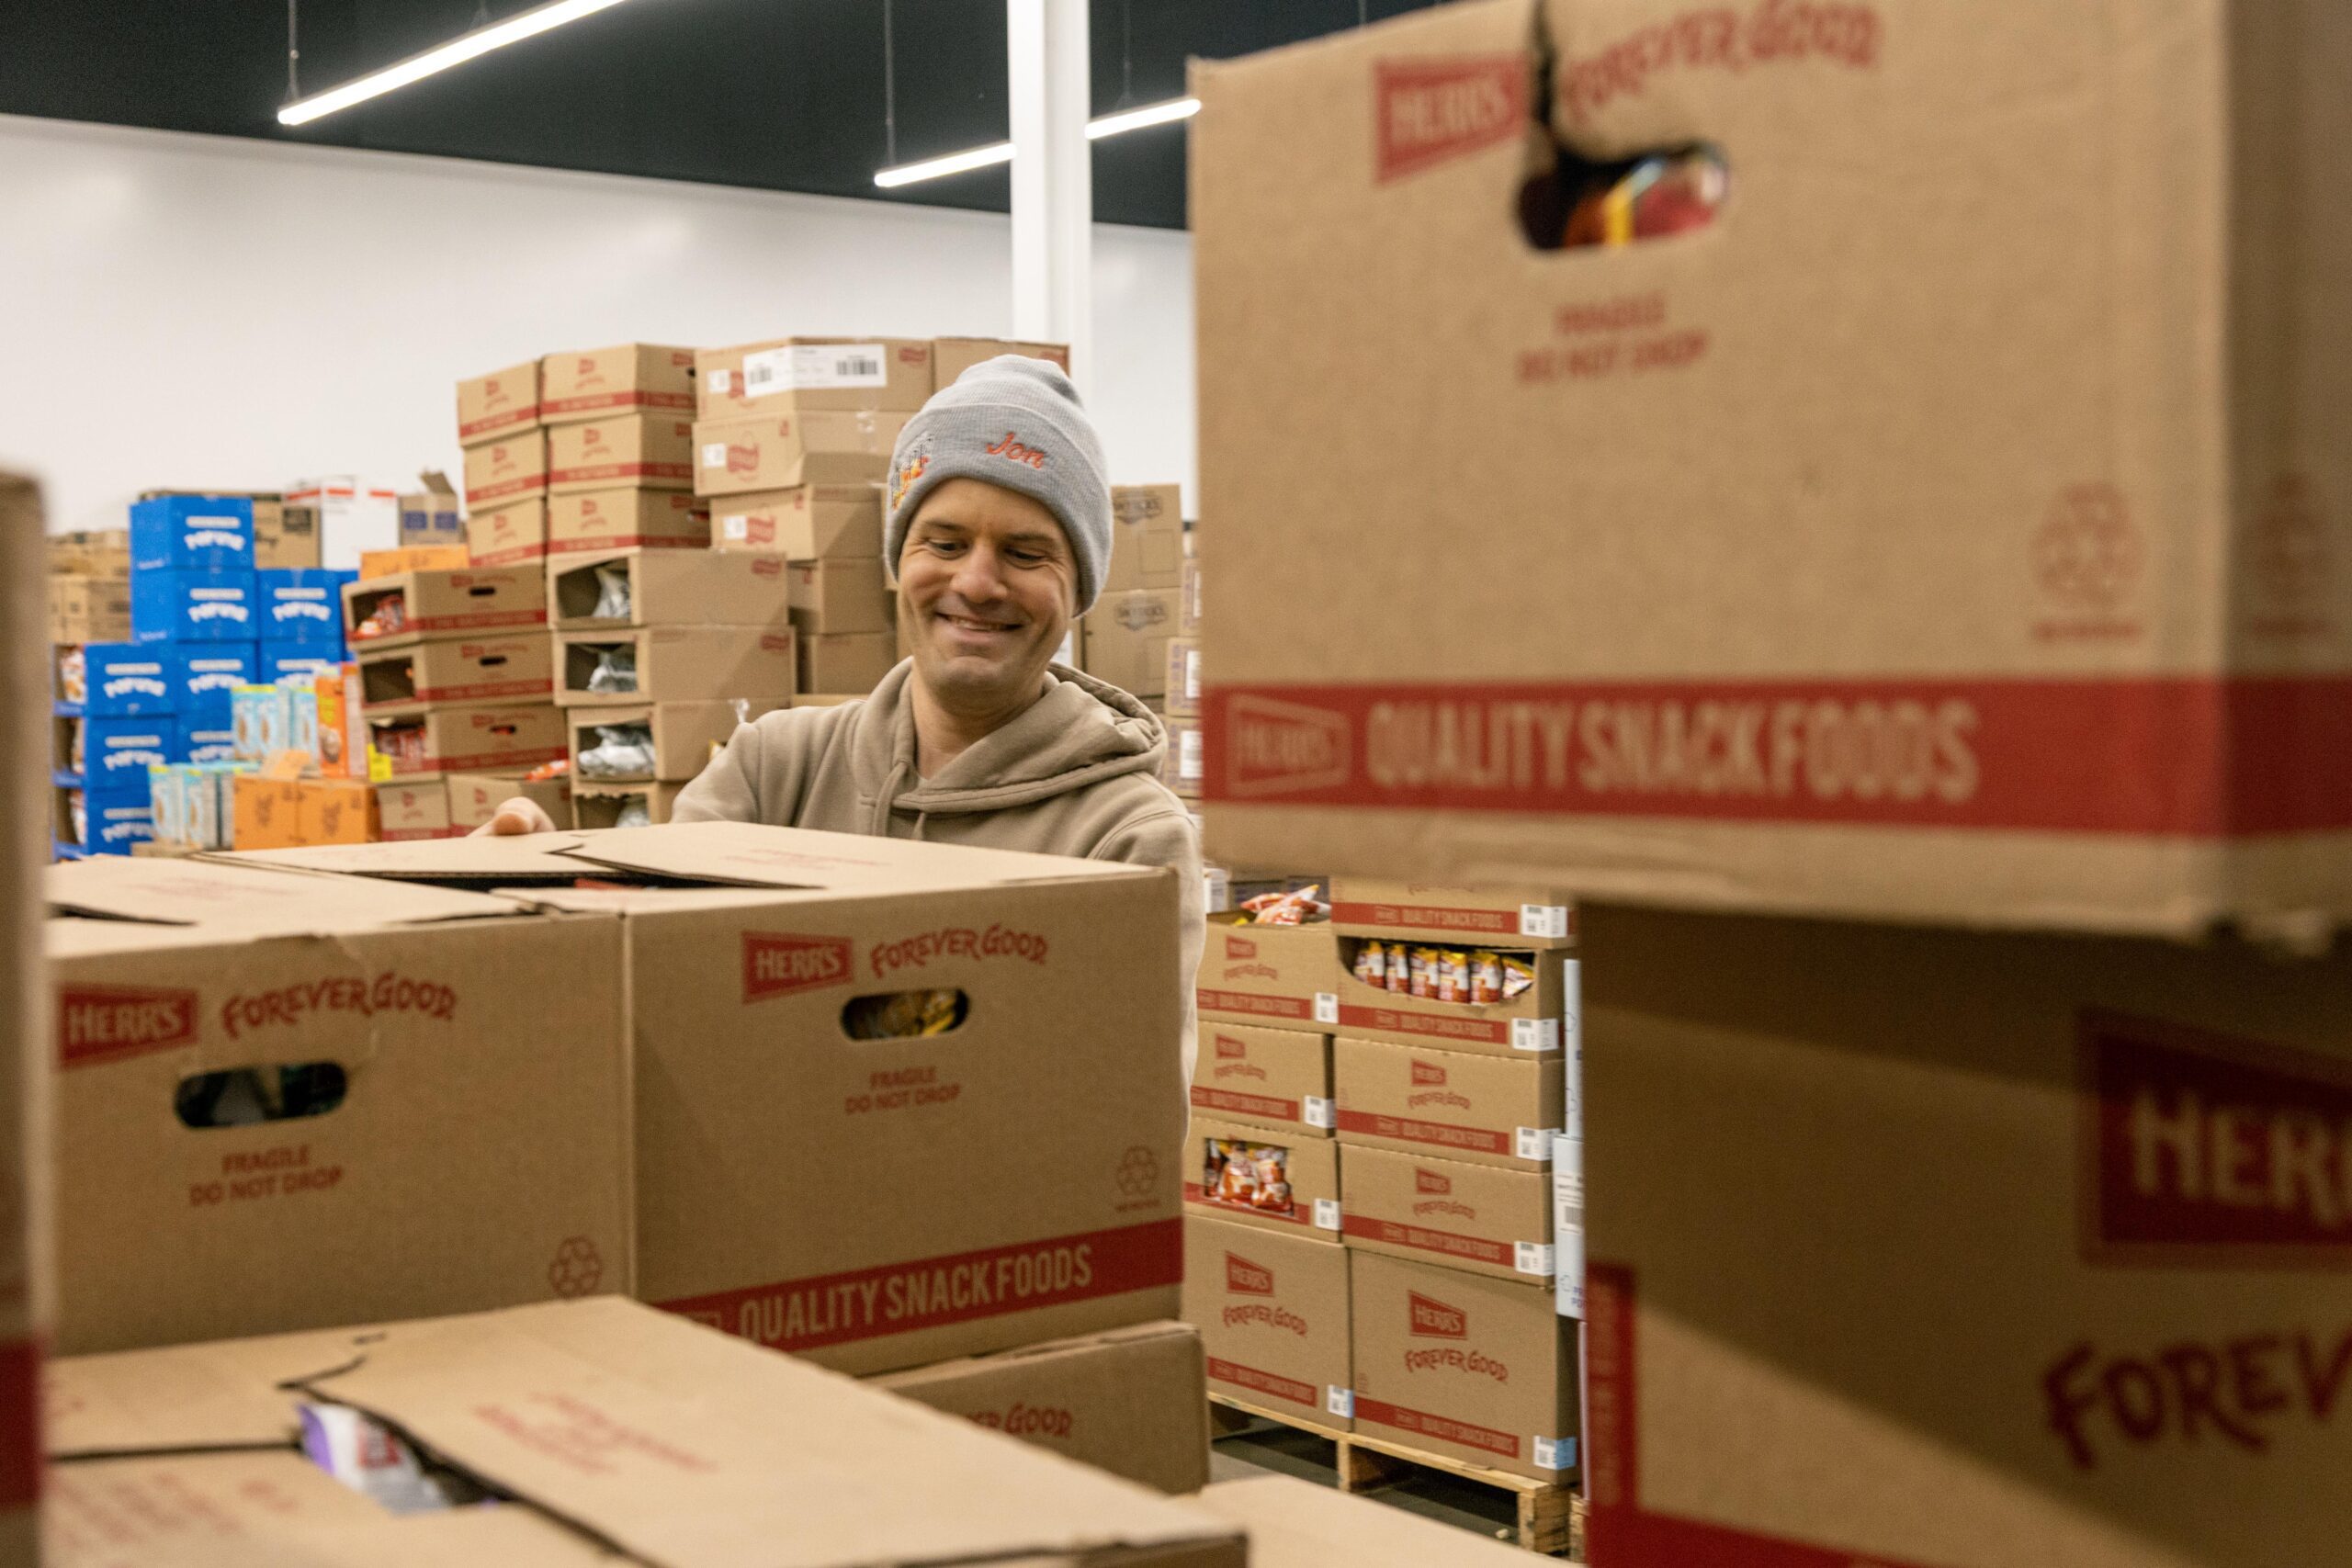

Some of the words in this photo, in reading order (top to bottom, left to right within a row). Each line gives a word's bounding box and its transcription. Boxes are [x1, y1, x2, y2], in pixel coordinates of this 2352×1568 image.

[986, 431, 1045, 469] Jon
[1365, 699, 1575, 794] QUALITY
[1576, 700, 1770, 797] SNACK
[1768, 698, 1980, 804] FOODS
[870, 928, 981, 979] FOREVER
[981, 923, 1049, 965] GOOD
[222, 976, 372, 1041] FOREVER
[371, 971, 458, 1022] GOOD
[869, 1065, 938, 1089] FRAGILE
[844, 1094, 871, 1115] DO
[876, 1089, 910, 1111] NOT
[915, 1082, 962, 1106] DROP
[222, 1144, 310, 1174] FRAGILE
[2130, 1088, 2352, 1227] HER
[190, 1179, 224, 1207] DO
[229, 1175, 274, 1201] NOT
[281, 1165, 343, 1196] DROP
[740, 1280, 879, 1344] QUALITY
[884, 1260, 995, 1319] SNACK
[994, 1244, 1093, 1298] FOODS
[1405, 1348, 1468, 1374] FOREVER
[1467, 1349, 1510, 1383] GOOD
[2041, 1321, 2352, 1472] FOREV
[1005, 1401, 1073, 1438] GOOD
